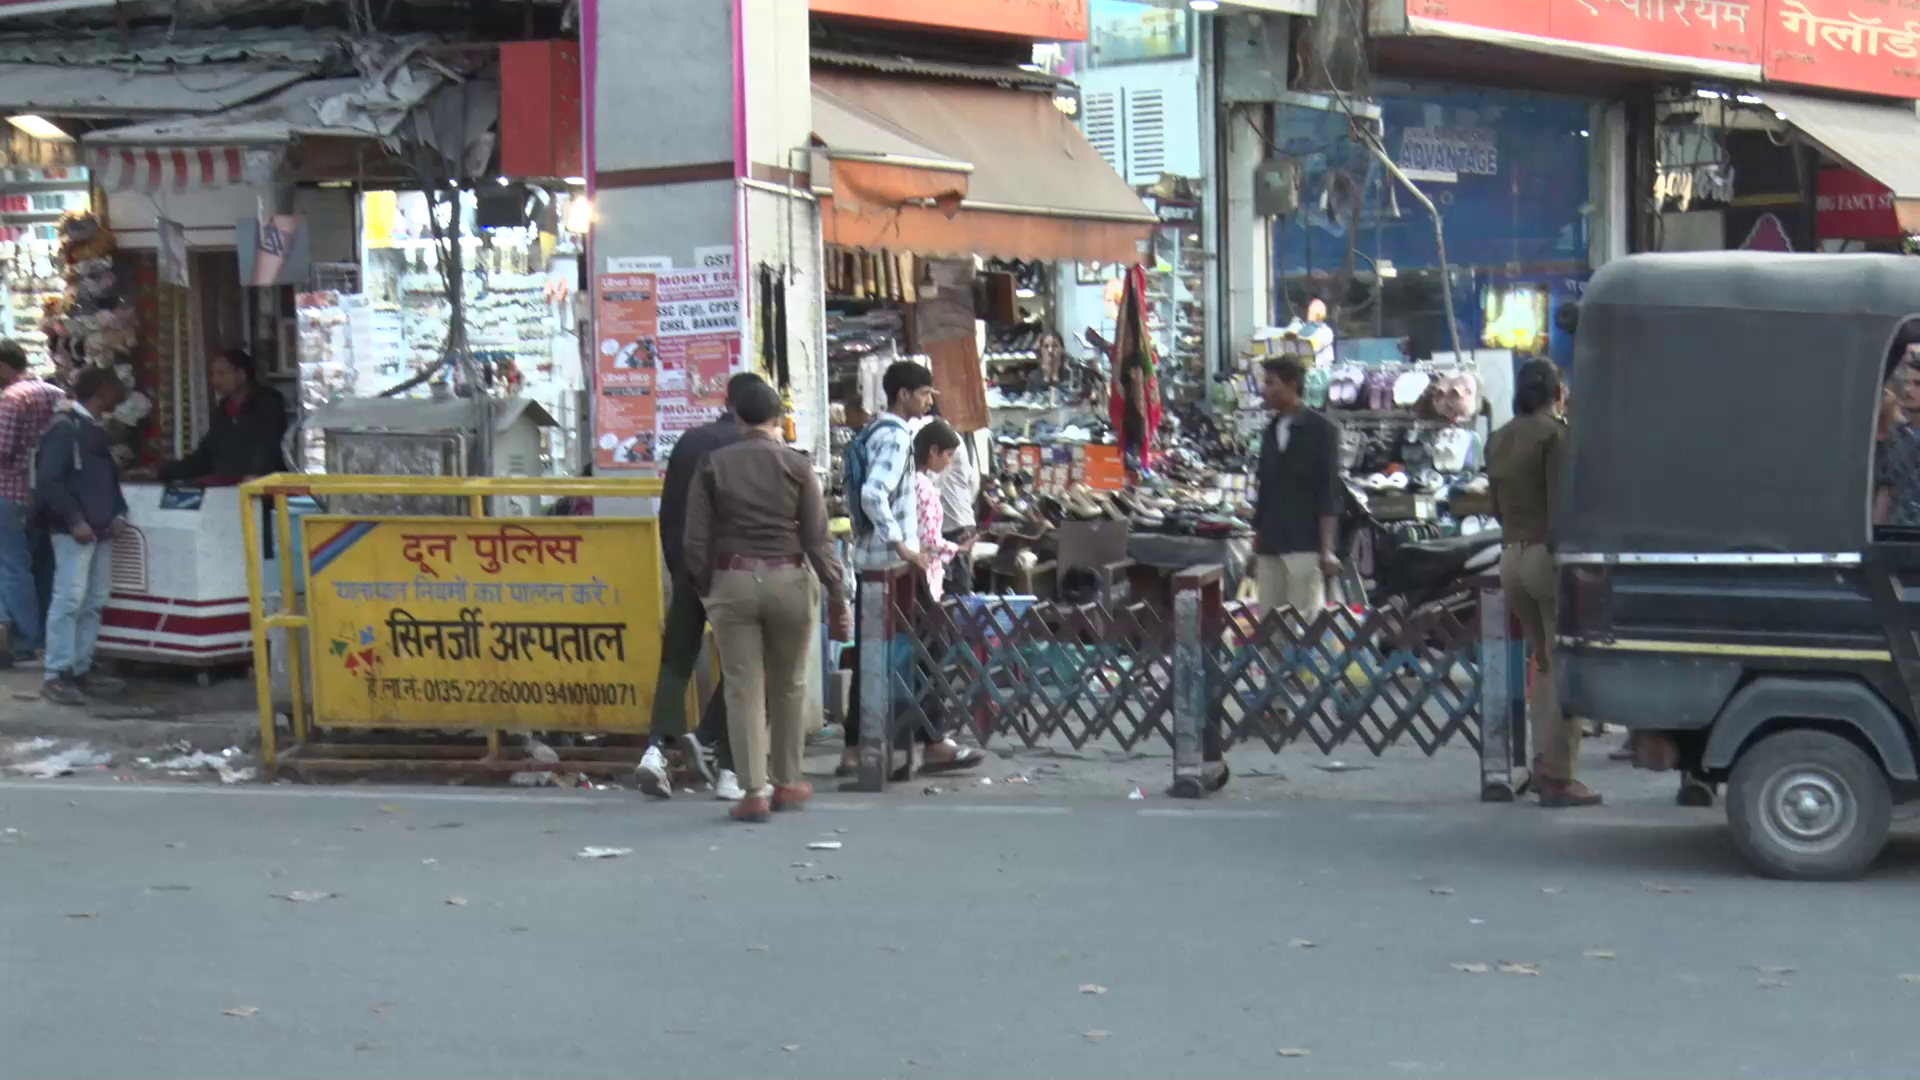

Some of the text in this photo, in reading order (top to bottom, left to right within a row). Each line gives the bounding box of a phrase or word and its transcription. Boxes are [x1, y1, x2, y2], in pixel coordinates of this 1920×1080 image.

[1400, 141, 1497, 175] ADVANTAGE
[703, 254, 732, 268] GST
[659, 273, 707, 286] MOUNT
[691, 315, 737, 329] BANKING
[402, 524, 584, 578] दून पुलिस
[473, 582, 502, 604] का
[506, 583, 565, 604] पालन
[385, 607, 627, 664] सिनर्जी अस्पताल
